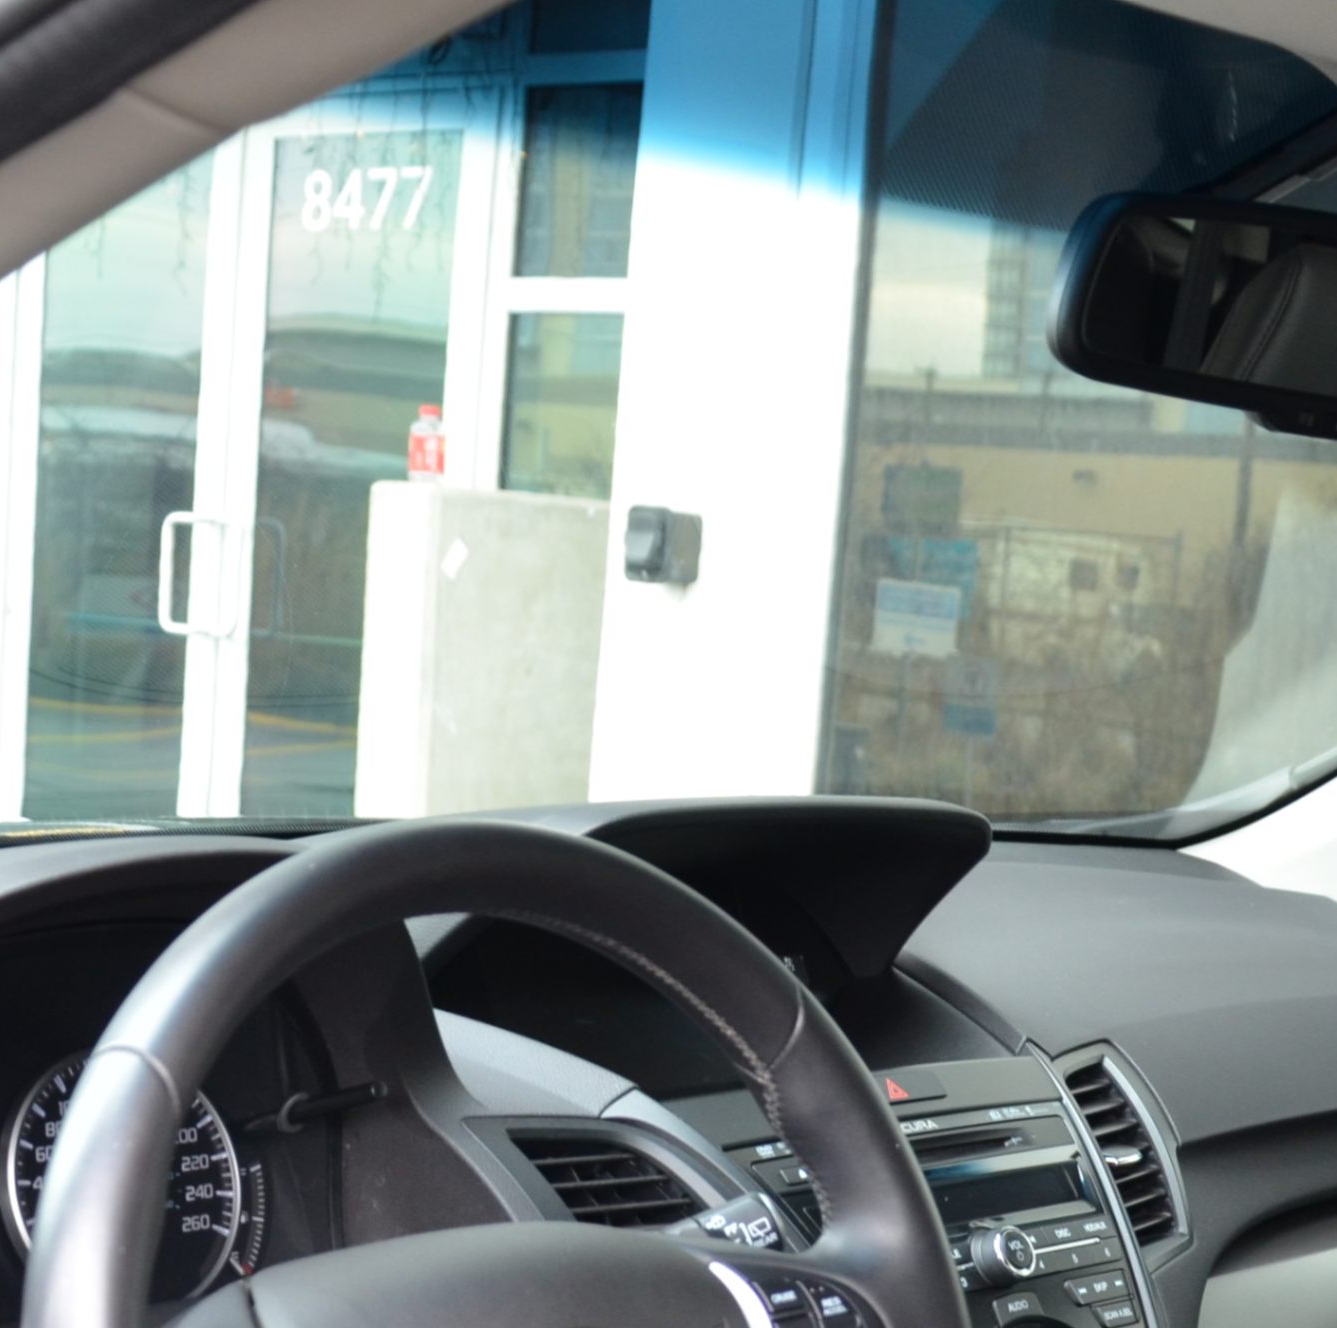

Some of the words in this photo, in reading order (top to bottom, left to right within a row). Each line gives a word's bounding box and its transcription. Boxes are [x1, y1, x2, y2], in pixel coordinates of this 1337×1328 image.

[301, 166, 432, 232] 8477
[181, 1155, 209, 1172] 220
[185, 1184, 214, 1202] 240
[181, 1214, 210, 1233] 260
[1054, 1227, 1071, 1240] DISC
[1007, 1239, 1024, 1250] VOL
[1039, 1259, 1045, 1270] 4
[1093, 1280, 1109, 1293] SKIP
[1007, 1299, 1029, 1313] AUDIO
